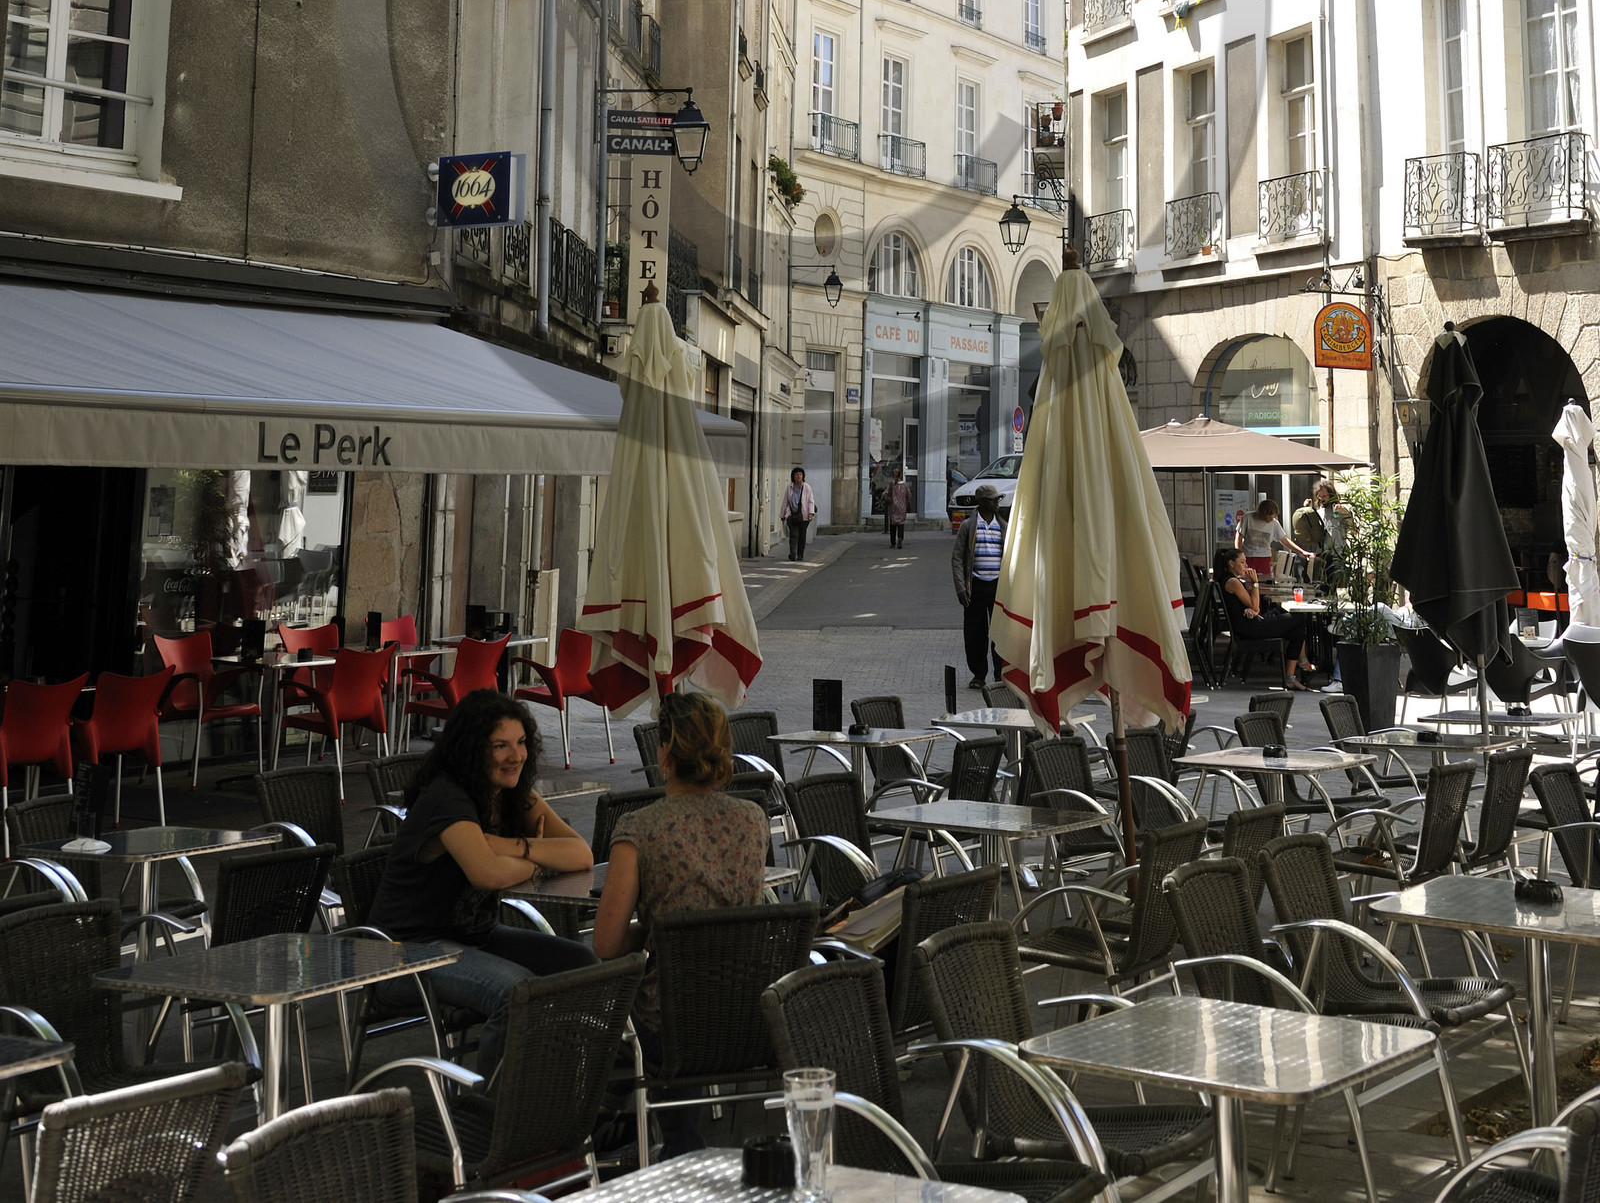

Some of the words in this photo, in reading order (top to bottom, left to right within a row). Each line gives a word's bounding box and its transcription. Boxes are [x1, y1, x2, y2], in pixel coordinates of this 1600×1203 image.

[611, 138, 672, 151] CANAL+
[455, 176, 492, 198] 1664
[907, 329, 920, 343] DU
[950, 336, 989, 353] PASSAGE
[1323, 333, 1364, 352] GRIMBERGEN
[258, 421, 301, 464] Le
[313, 423, 391, 466] Perk
